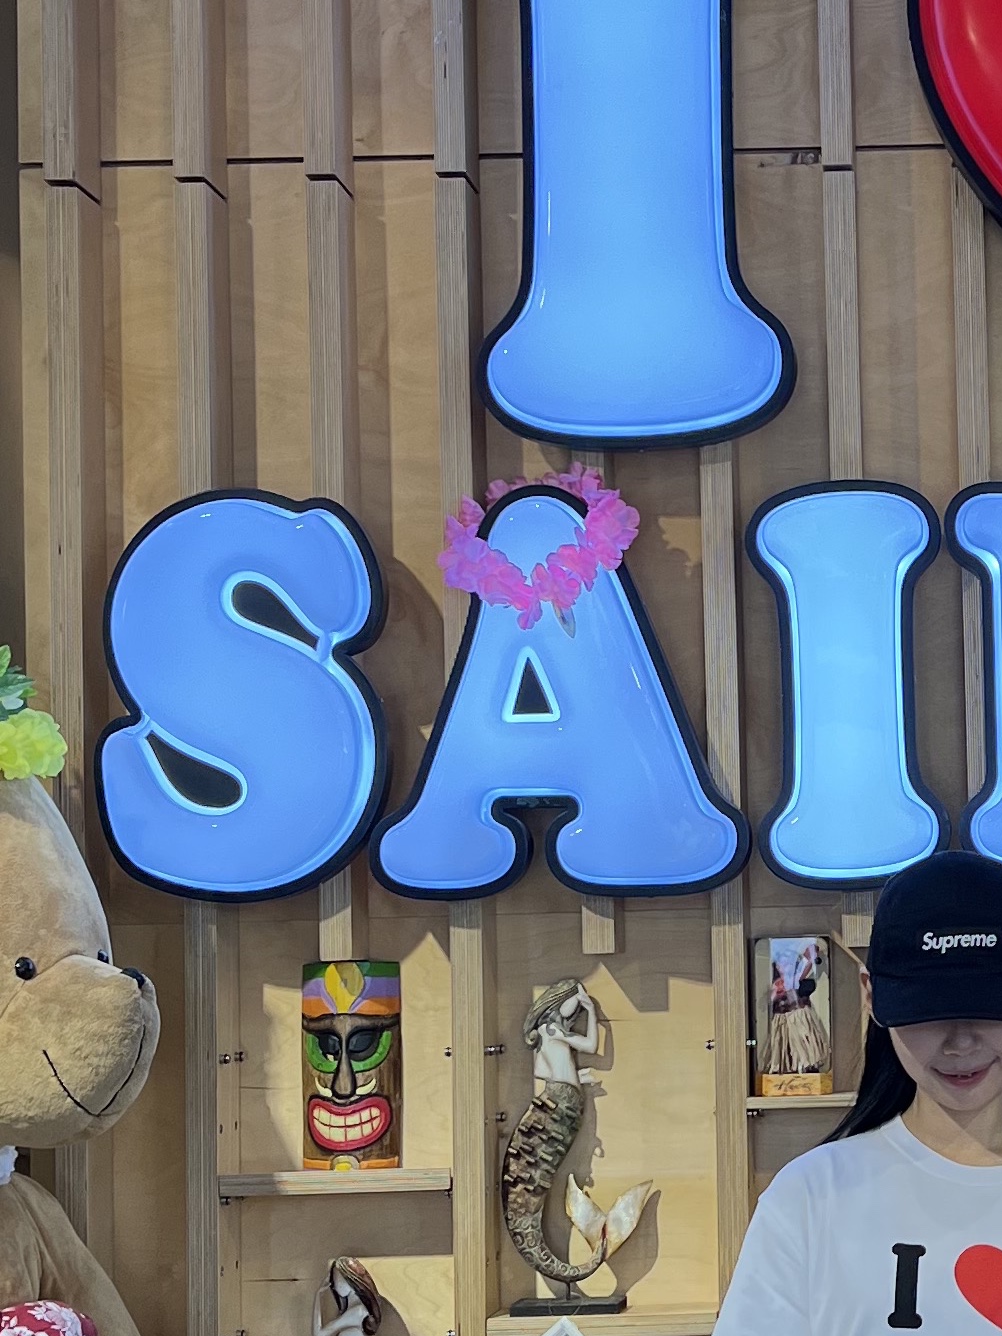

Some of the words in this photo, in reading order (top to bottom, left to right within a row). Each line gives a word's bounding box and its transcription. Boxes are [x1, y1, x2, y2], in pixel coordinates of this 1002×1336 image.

[477, 0, 796, 450] I
[921, 932, 998, 954] Supreme
[888, 1243, 927, 1329] I
